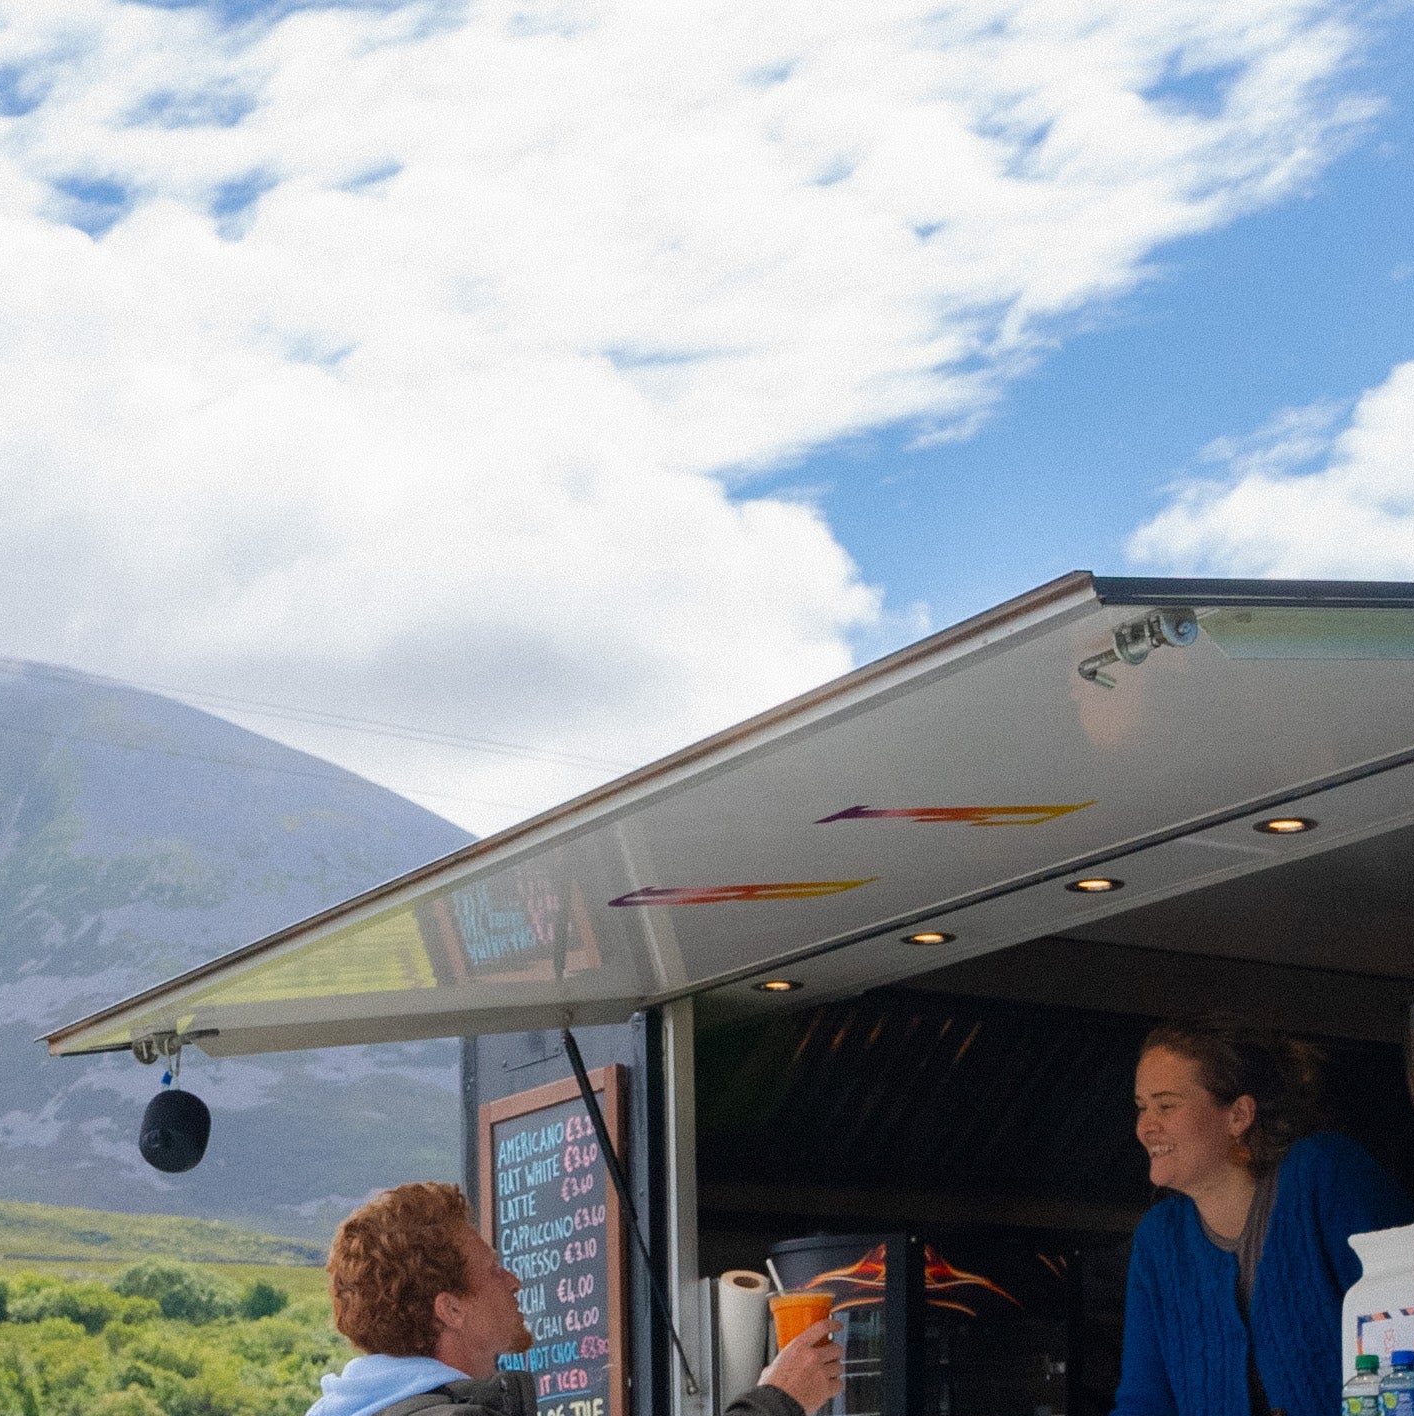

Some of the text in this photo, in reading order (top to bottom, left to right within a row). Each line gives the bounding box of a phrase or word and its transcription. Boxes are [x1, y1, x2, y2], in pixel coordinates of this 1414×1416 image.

[497, 1122, 565, 1168] AMERICANO
[498, 1143, 598, 1197] FLAT WHITE €3.60
[499, 1190, 537, 1225] LATTE
[500, 1215, 574, 1255] CAPPUCCINO
[502, 1237, 597, 1283] ESPRESSO €3.10
[513, 1273, 594, 1316] OCHA €4.00
[534, 1315, 563, 1341] CHAI
[565, 1306, 600, 1332] €4.00
[556, 1368, 589, 1392] ICED
